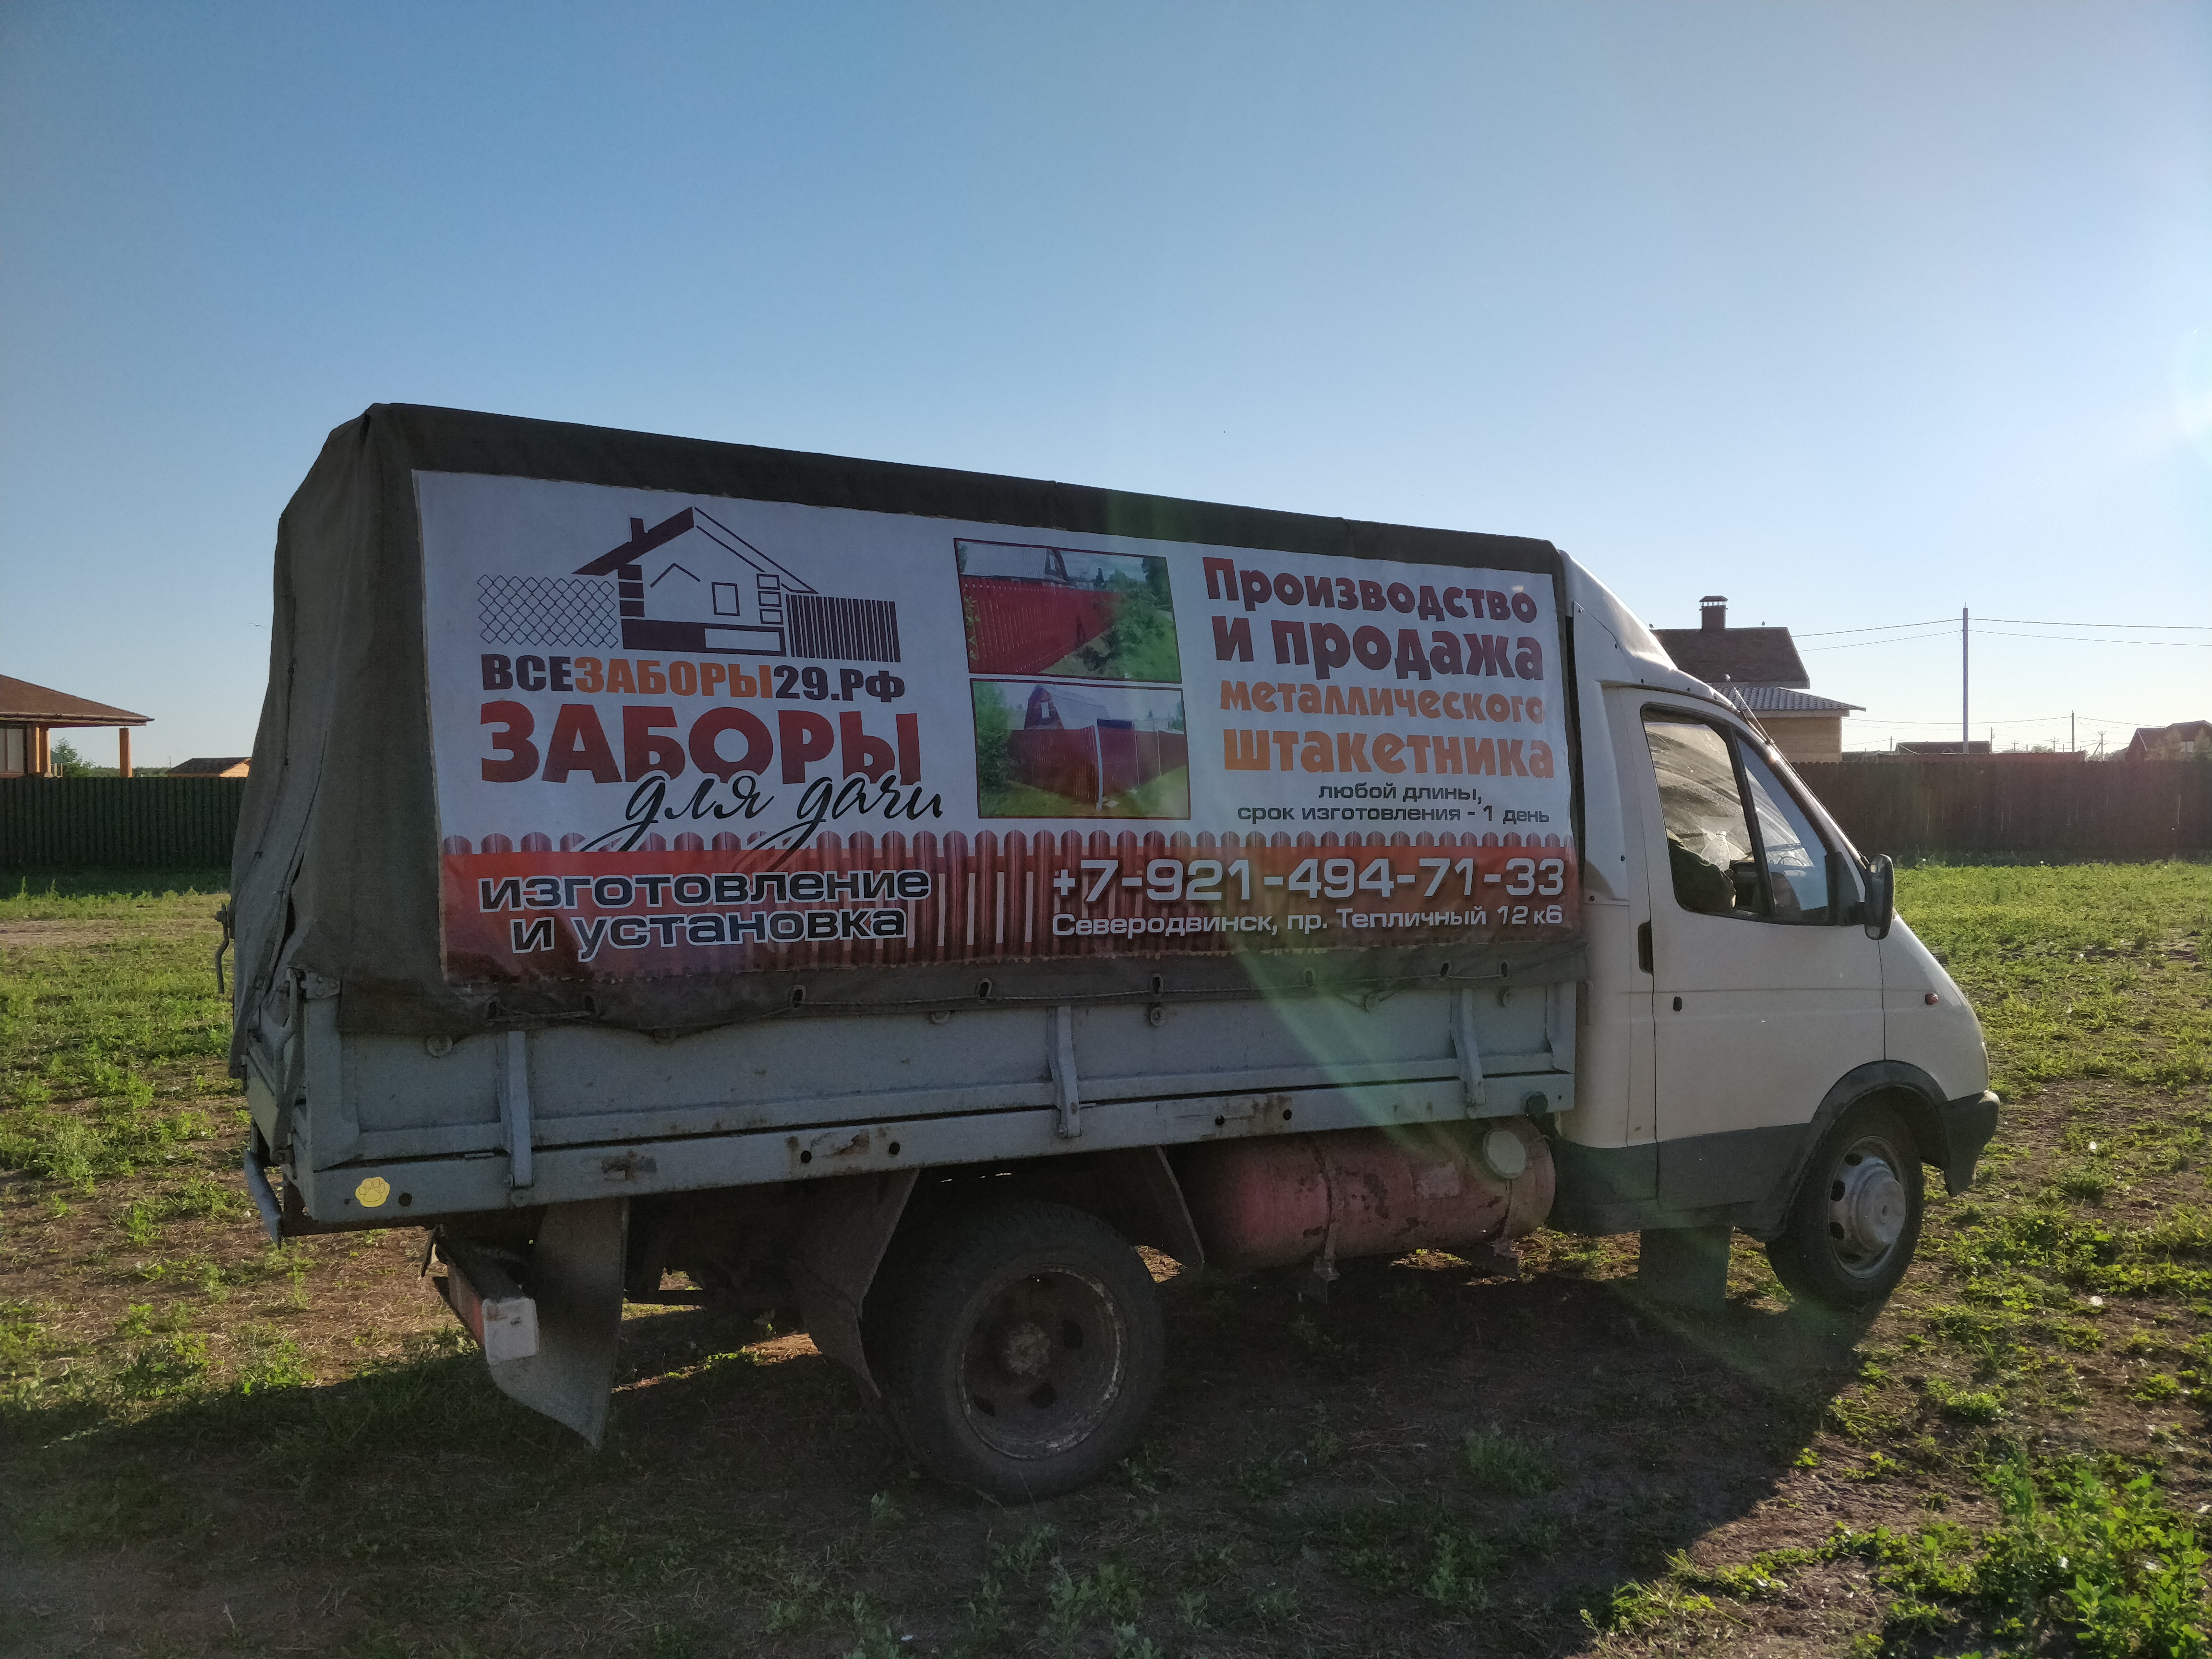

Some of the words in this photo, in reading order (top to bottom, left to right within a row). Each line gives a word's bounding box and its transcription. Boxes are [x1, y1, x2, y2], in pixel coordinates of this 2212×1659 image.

[1202, 557, 1537, 623] Производство
[1212, 615, 1254, 662] и
[1271, 619, 1544, 681] продажа
[481, 653, 905, 703] ВСЕЗАБОРЫ29.РФ
[1220, 680, 1545, 725] металлического
[480, 700, 922, 786] ЗАБОРЫ
[1223, 728, 1555, 779] штакетника
[1237, 806, 1295, 825] срок
[1301, 807, 1461, 822] изготовления
[1482, 805, 1493, 822] 1
[1503, 808, 1550, 825] день
[1318, 782, 1396, 800] любой
[1403, 787, 1482, 805] длины,
[578, 775, 774, 853] для
[732, 775, 944, 872] дачи
[479, 870, 930, 912] изготовление
[1053, 857, 1565, 902] +7-921-494-71-33
[511, 916, 555, 954] и
[574, 907, 908, 962] установка
[1052, 914, 1277, 938] Северодвинск,
[1287, 913, 1328, 937] пр.
[1337, 906, 1486, 928] Тепличный
